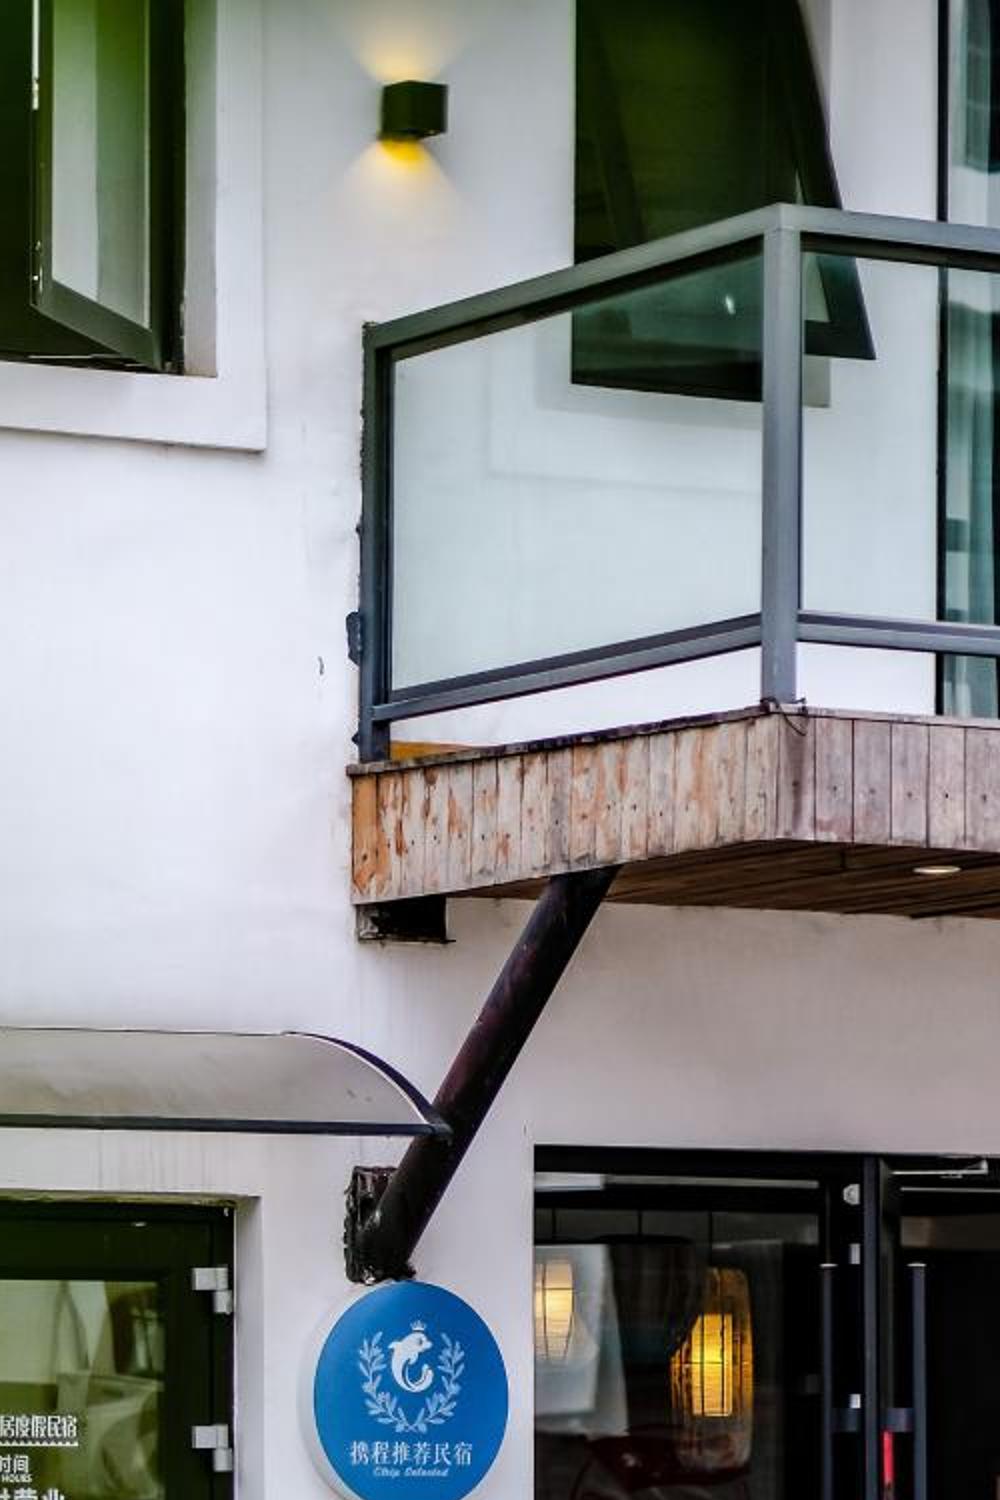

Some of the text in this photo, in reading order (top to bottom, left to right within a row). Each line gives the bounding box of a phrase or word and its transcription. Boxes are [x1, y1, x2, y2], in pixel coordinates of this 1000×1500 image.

[350, 1441, 473, 1466] 携程推荐民宿
